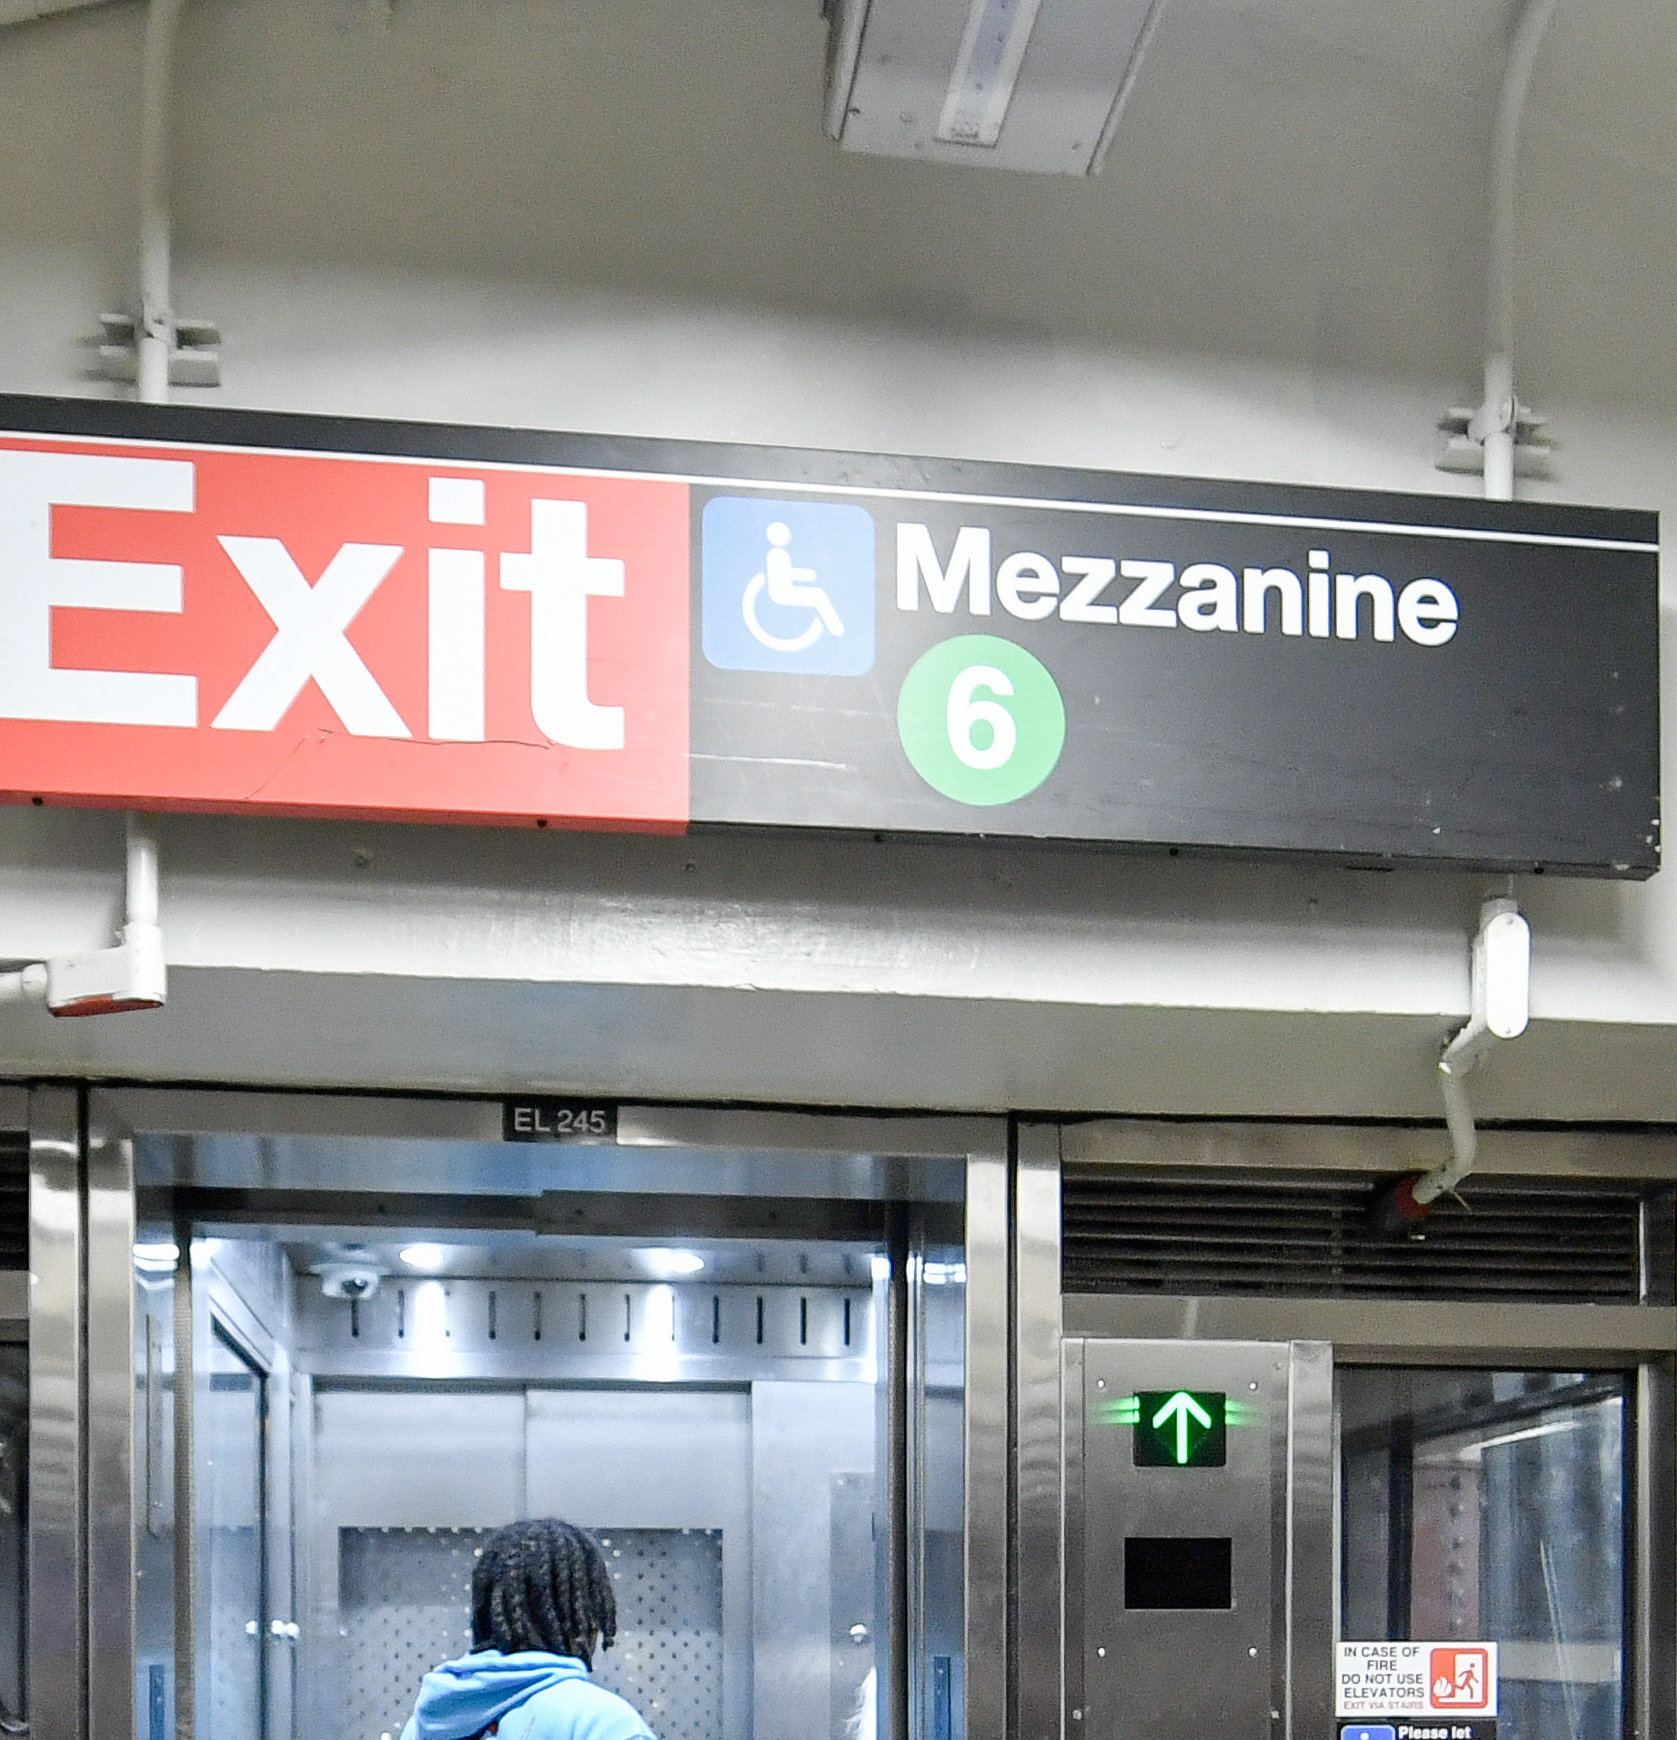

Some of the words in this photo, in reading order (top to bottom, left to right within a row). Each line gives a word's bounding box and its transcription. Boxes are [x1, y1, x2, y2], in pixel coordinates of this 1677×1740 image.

[895, 523, 1461, 648] Mezzanine
[946, 666, 1016, 769] 6
[514, 1108, 551, 1132] EL
[557, 1109, 606, 1134] 245
[1344, 1647, 1357, 1657] IN
[1361, 1647, 1397, 1657] CASE
[1401, 1647, 1420, 1657] OF
[1367, 1660, 1398, 1671] FIRE
[1341, 1674, 1362, 1685] DO
[1365, 1674, 1391, 1685] NOT
[1396, 1673, 1423, 1684] USE
[1344, 1687, 1425, 1698] ELEVATORS
[1343, 1701, 1366, 1710] EXIT
[1387, 1701, 1424, 1710] STAIRS
[1398, 1725, 1448, 1740] Please
[1451, 1725, 1471, 1739] let
